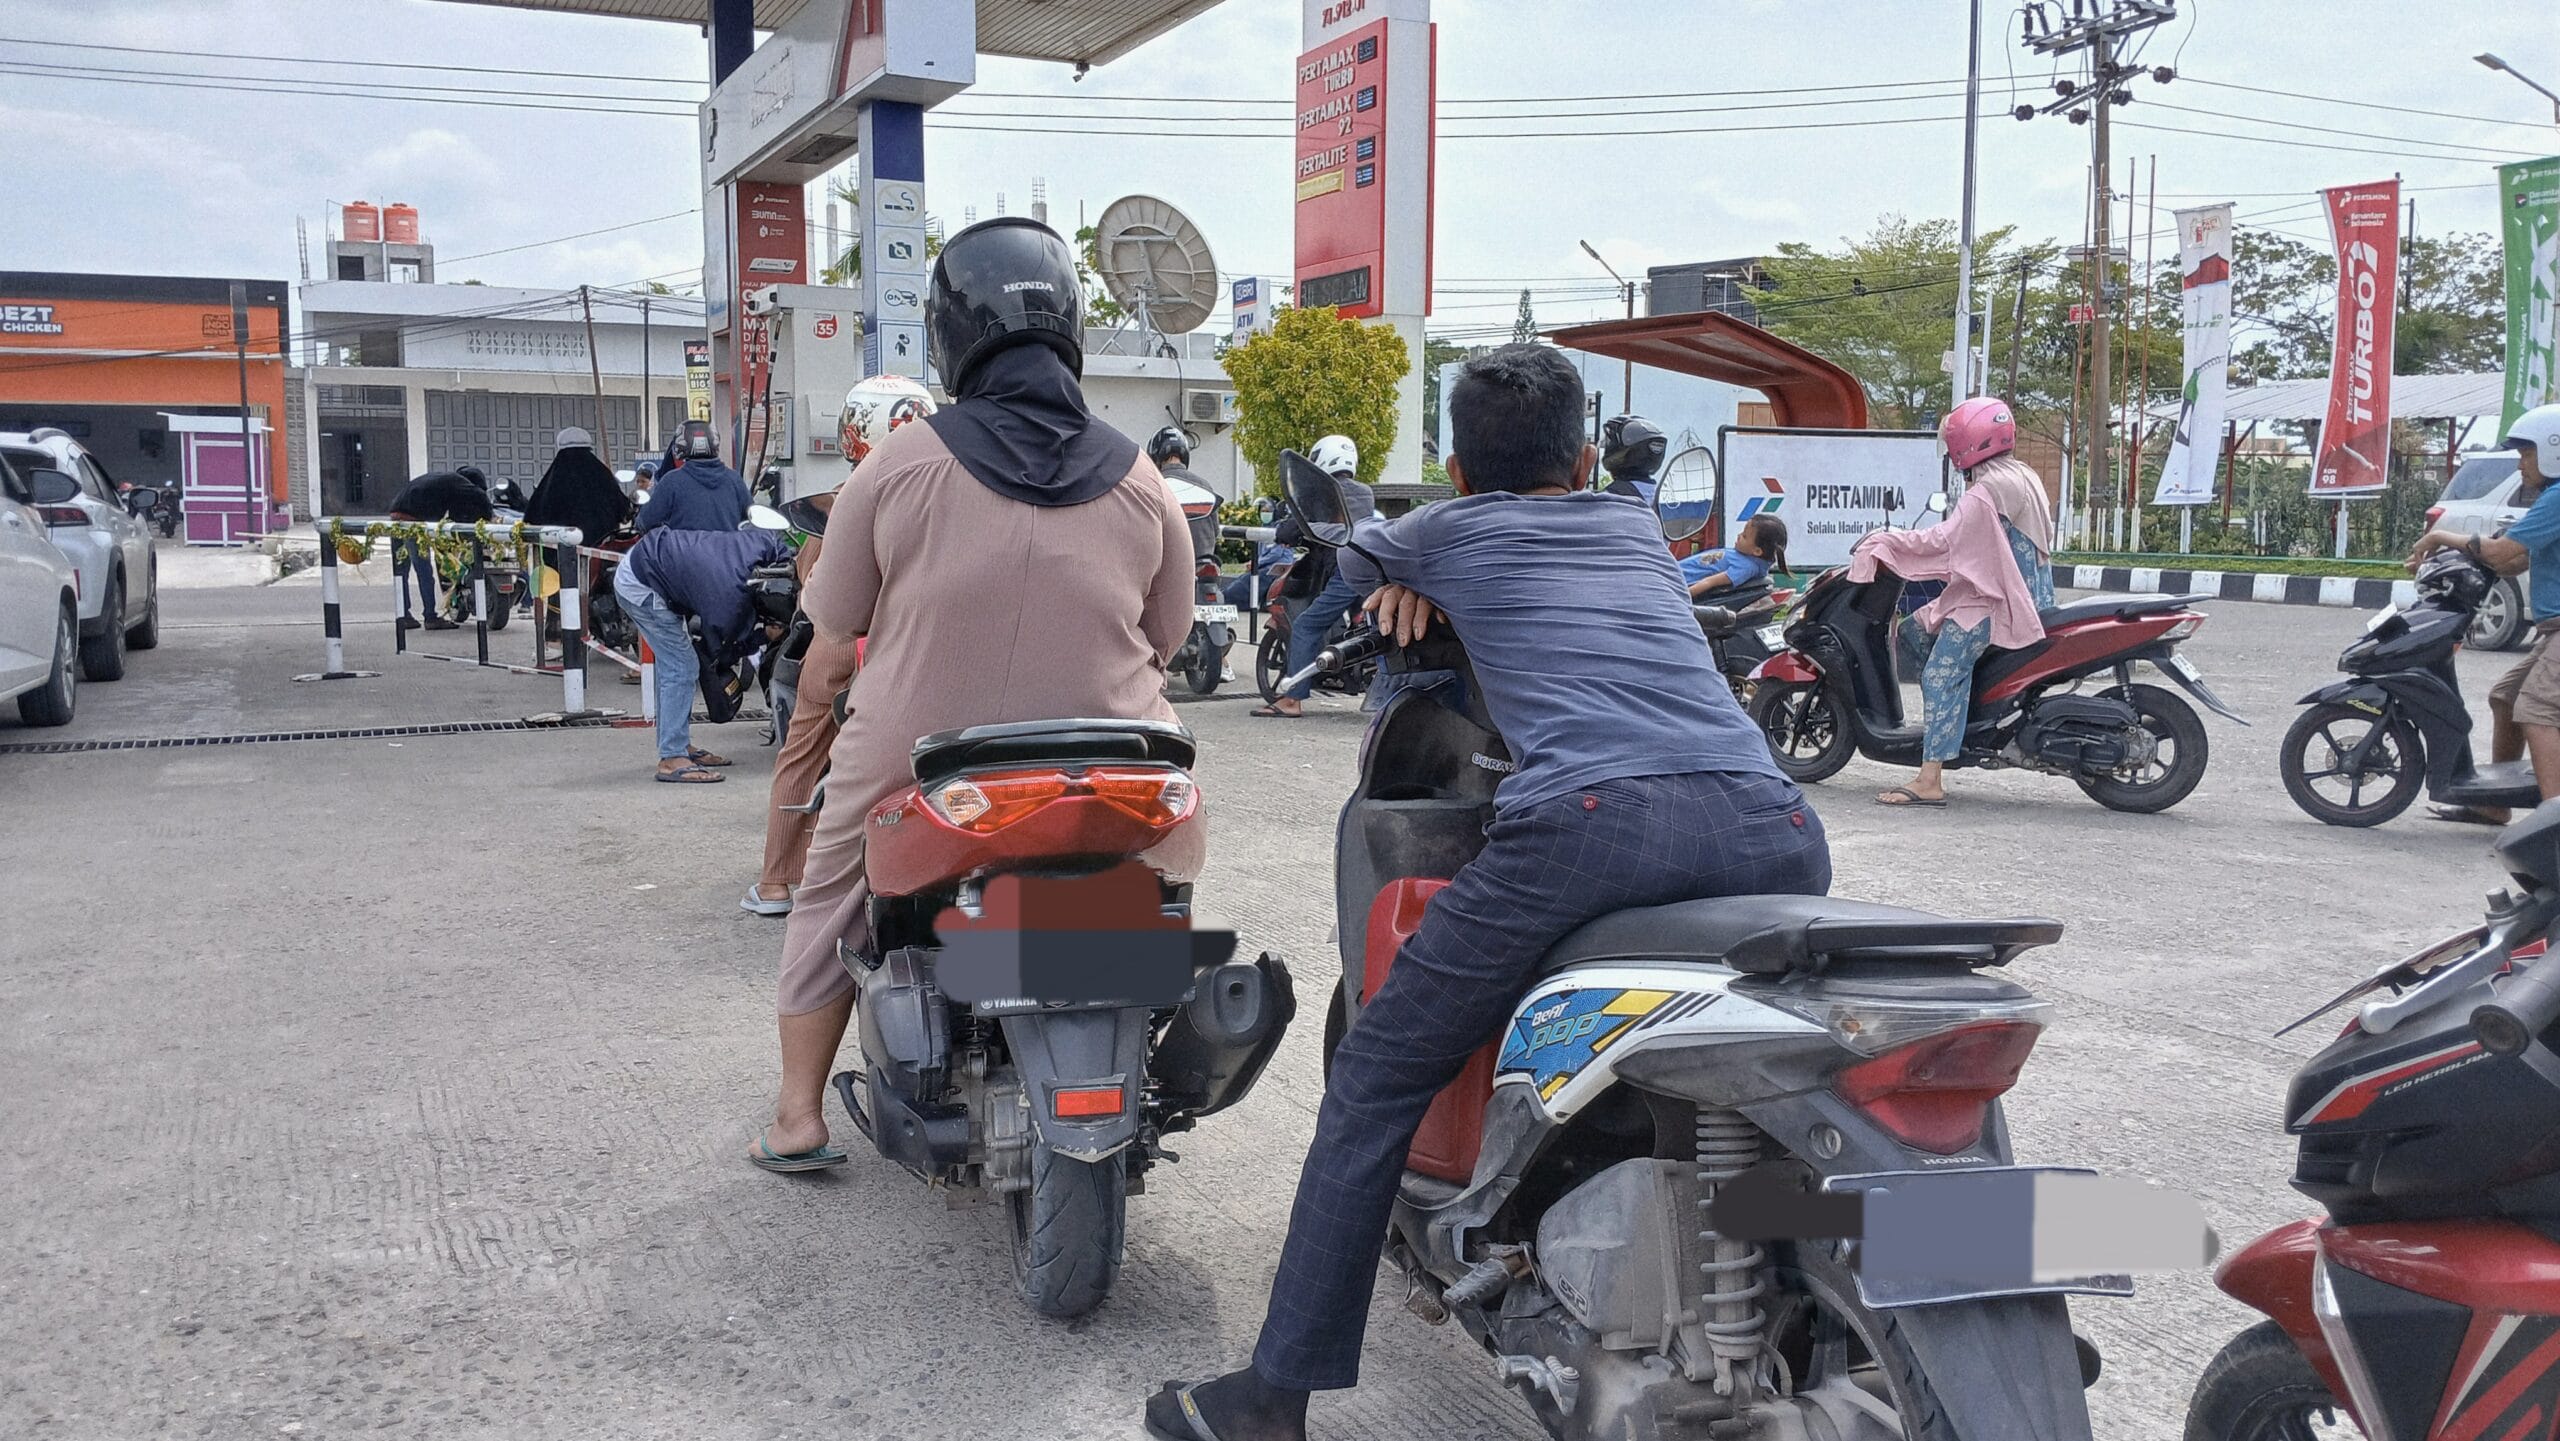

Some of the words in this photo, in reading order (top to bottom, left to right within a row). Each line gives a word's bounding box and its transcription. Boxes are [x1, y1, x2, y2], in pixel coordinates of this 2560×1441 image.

[1299, 46, 1356, 85] PERTAMAX
[1324, 67, 1355, 94] TURBO
[1299, 94, 1354, 131] PERTAMAX
[1338, 116, 1353, 137] 92
[1298, 145, 1348, 177] PERTALITE
[1002, 281, 1054, 293] HONDA
[3, 322, 62, 332] CHICKEN
[1237, 312, 1254, 328] ATM
[2353, 271, 2376, 424] TURBO
[2322, 475, 2336, 484] 98
[1807, 521, 1836, 534] Selalu
[994, 998, 1037, 1008] YAMAHA
[2384, 1081, 2412, 1096] LED
[1921, 1156, 1985, 1165] HONDA
